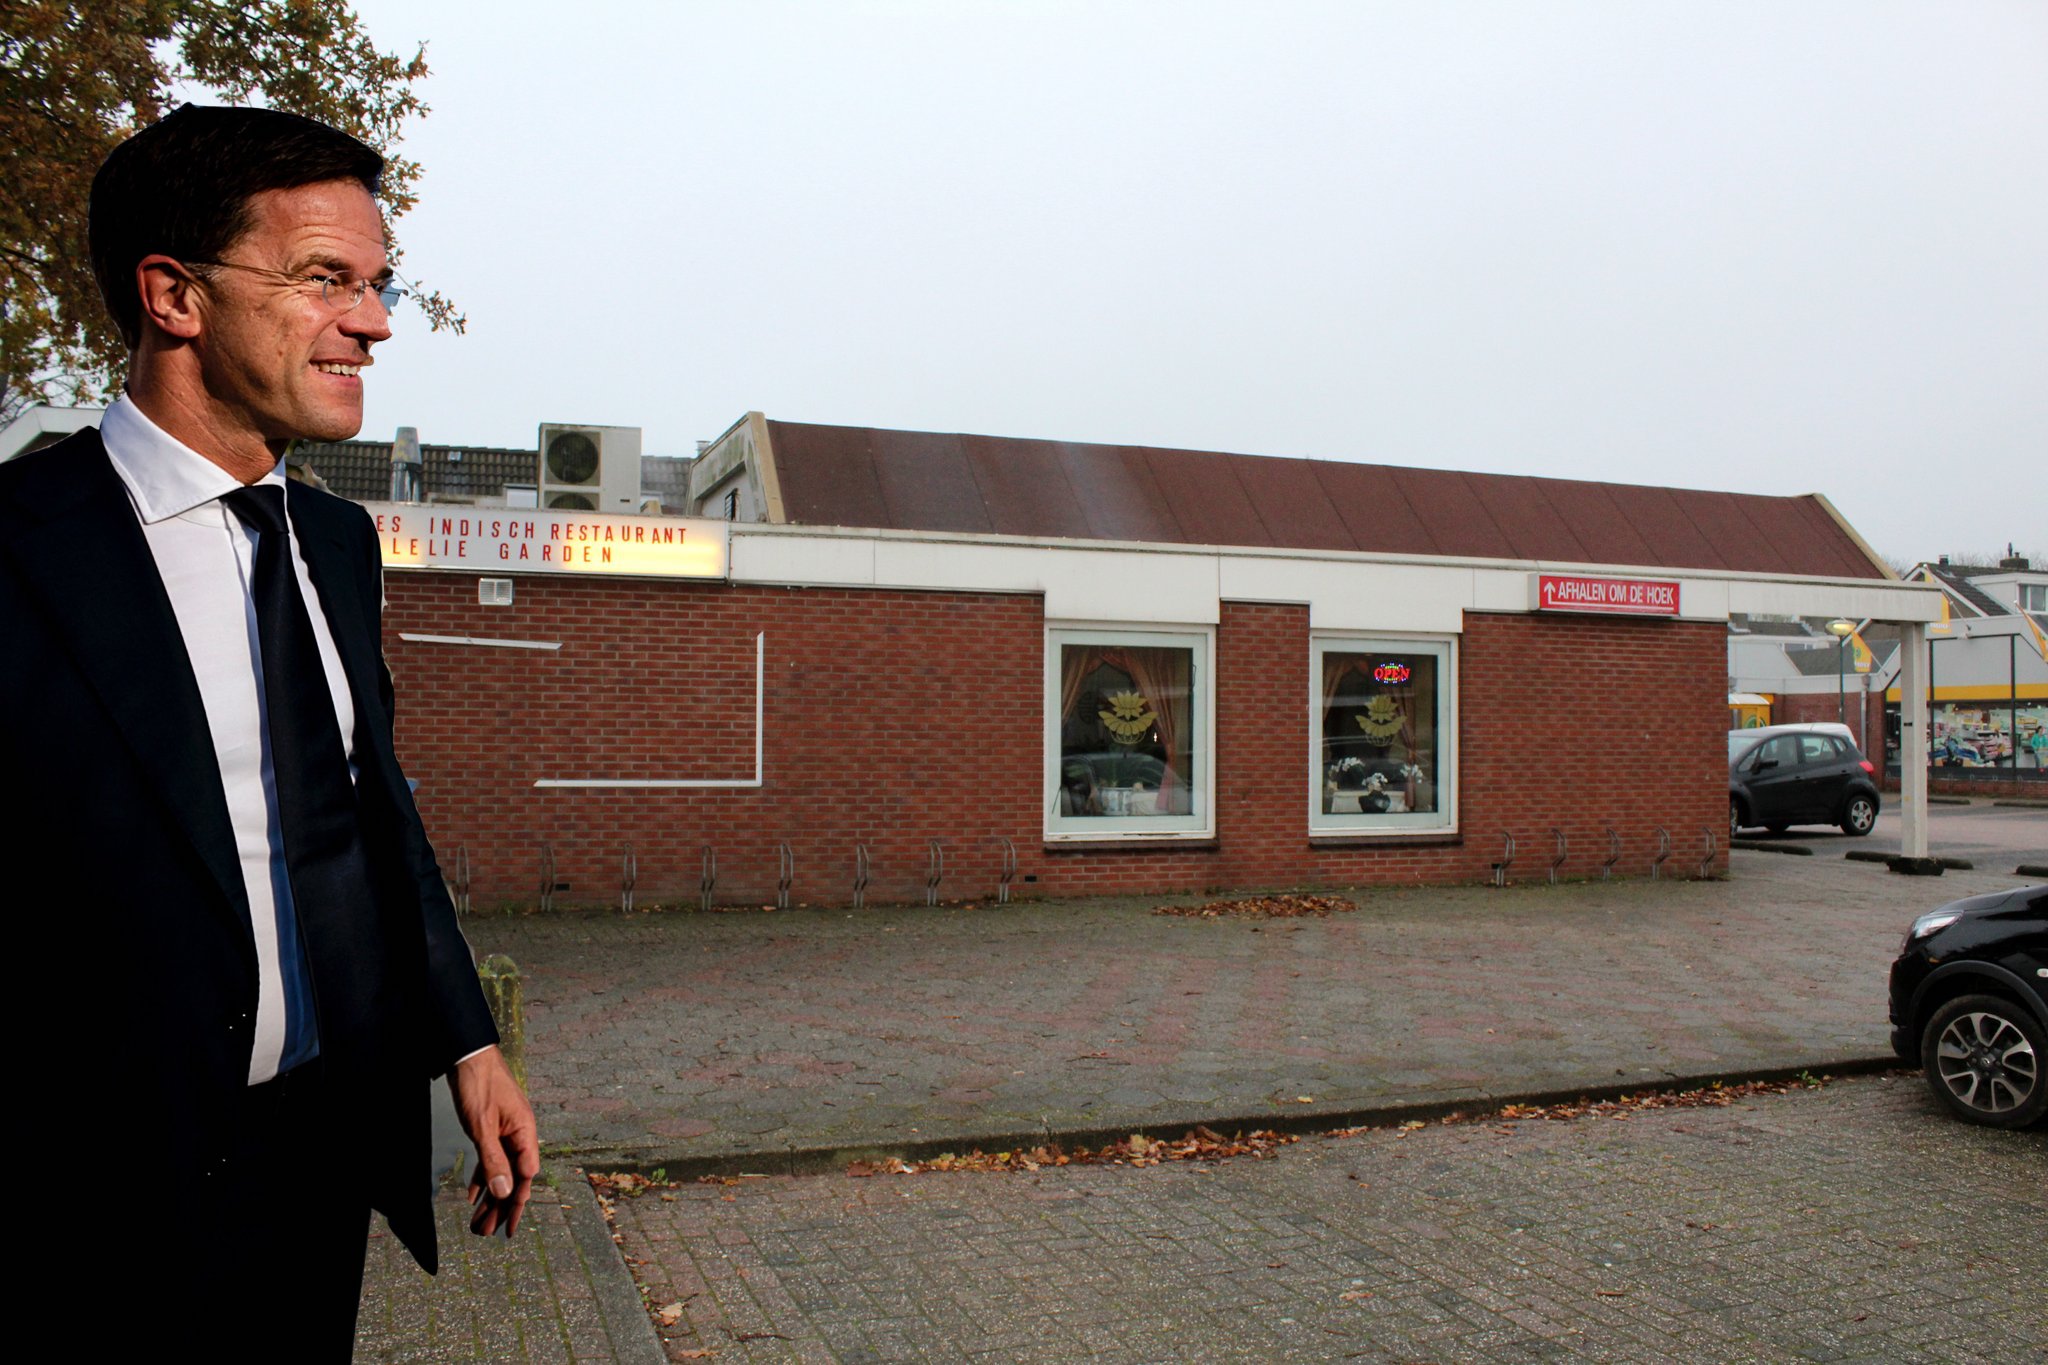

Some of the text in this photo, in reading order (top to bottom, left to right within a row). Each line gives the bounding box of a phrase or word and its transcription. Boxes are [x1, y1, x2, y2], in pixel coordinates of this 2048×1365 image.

[430, 517, 534, 539] INDISCH
[551, 523, 688, 545] RESTAURANT
[392, 537, 612, 563] LELIE GARDEN
[1557, 580, 1674, 605] AFHALEN OM DE HOEK
[1374, 667, 1411, 681] OPEN
